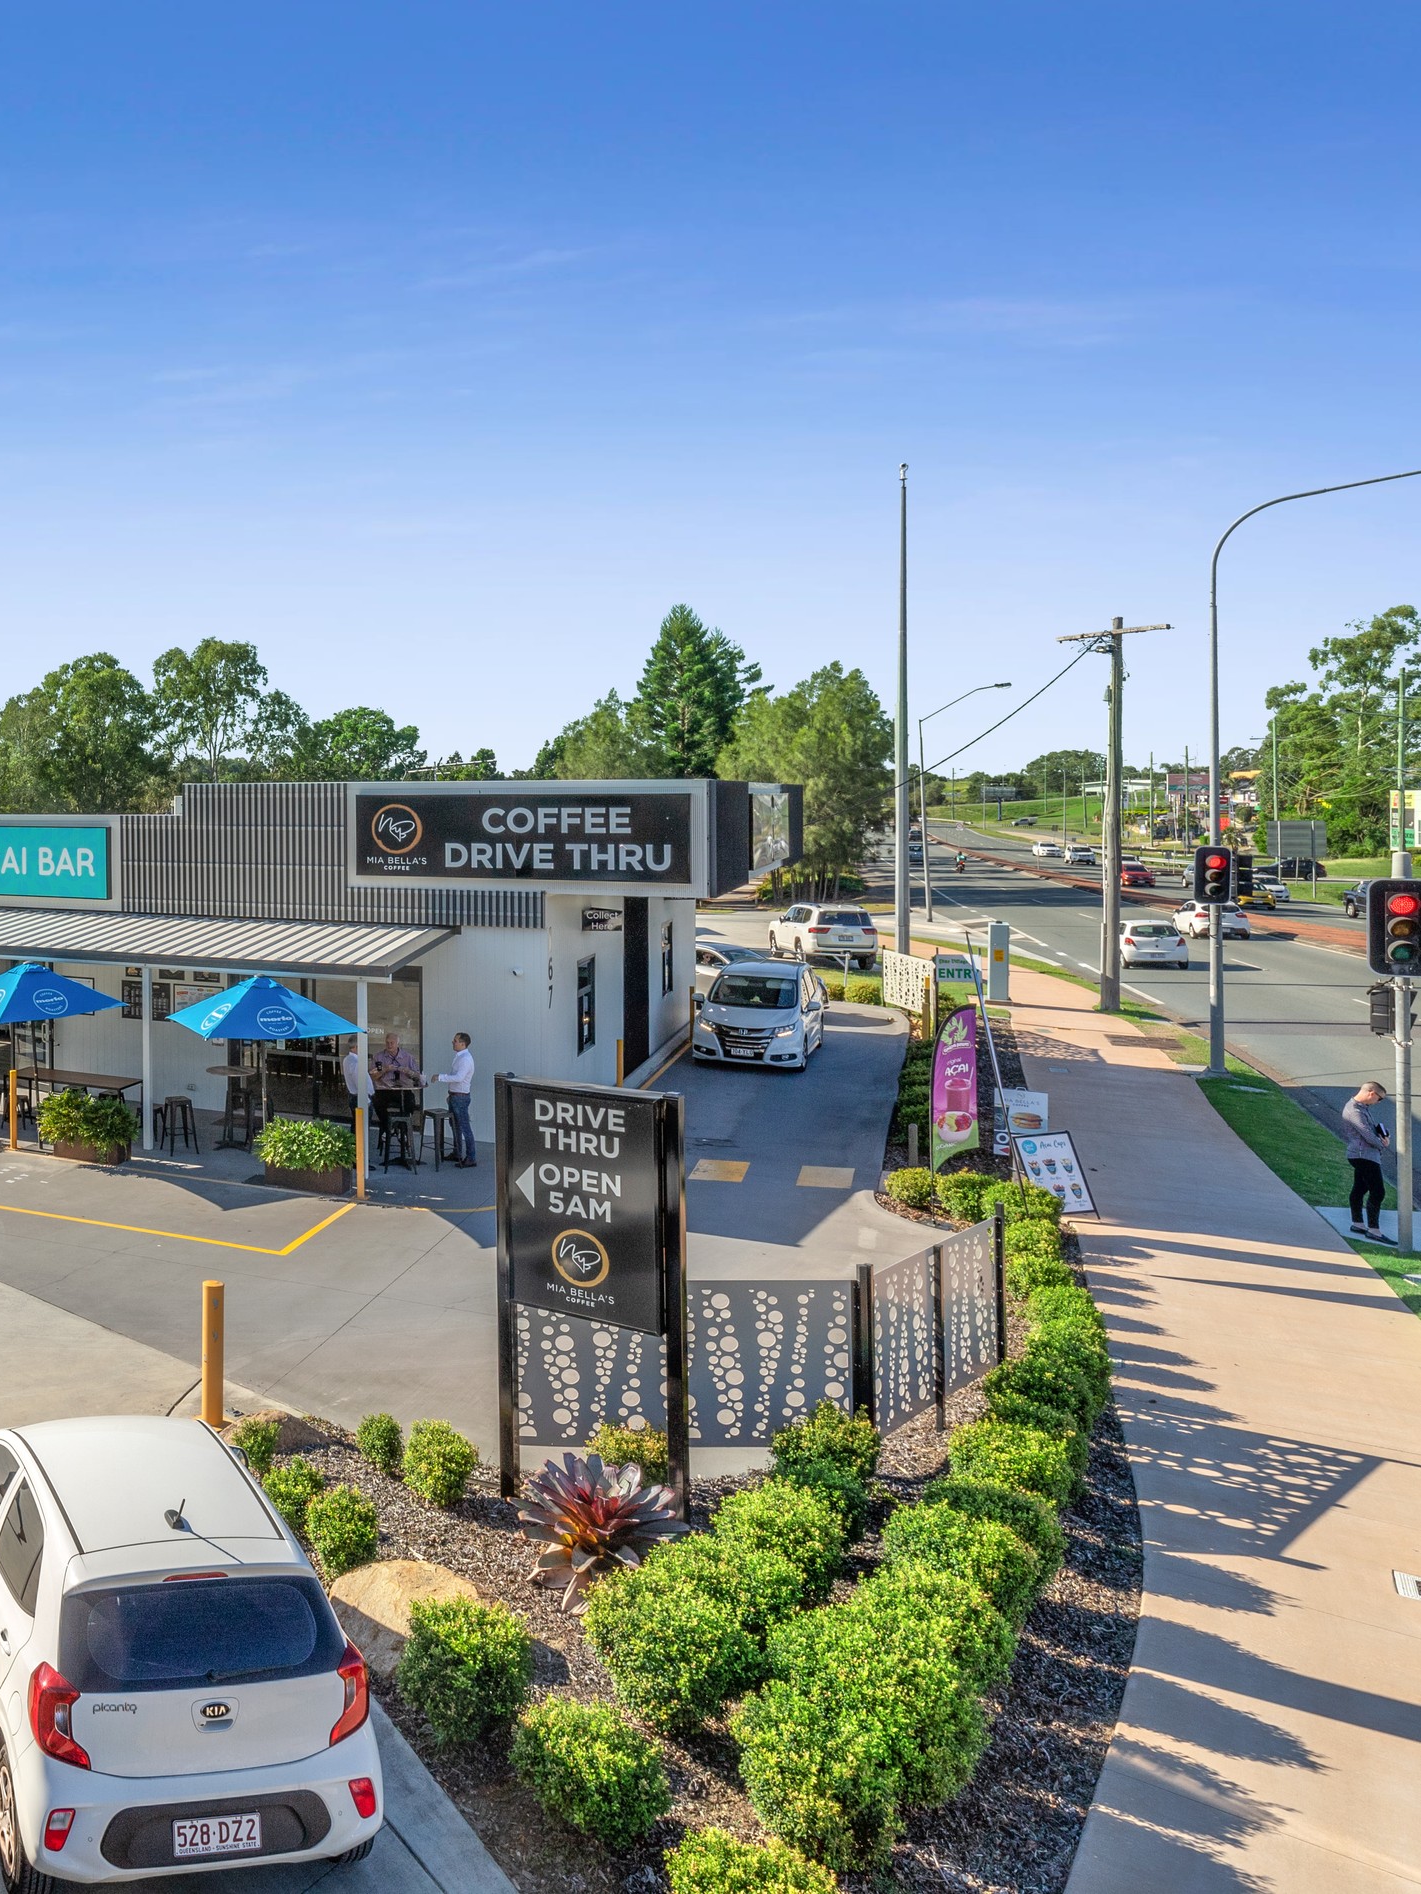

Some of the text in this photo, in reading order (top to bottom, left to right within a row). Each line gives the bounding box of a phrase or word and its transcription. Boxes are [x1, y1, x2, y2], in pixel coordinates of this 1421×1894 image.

[482, 807, 631, 834] COFFEE
[39, 847, 95, 877] BAR
[366, 856, 427, 865] MIA BELLA'S
[445, 842, 671, 871] DRIVE THRU
[586, 911, 618, 920] Collect
[591, 922, 614, 930] Here
[535, 1099, 626, 1133] DRIVE
[539, 1126, 620, 1159] THRU
[538, 1163, 621, 1197] OPEN
[548, 1191, 612, 1223] 5AM
[546, 1282, 615, 1305] MIA BELLA'S
[566, 1296, 596, 1308] COFFEE
[93, 1702, 227, 1717] picanto KIA
[179, 1841, 257, 1855] QUEENSLAND SUNSHINE STATE
